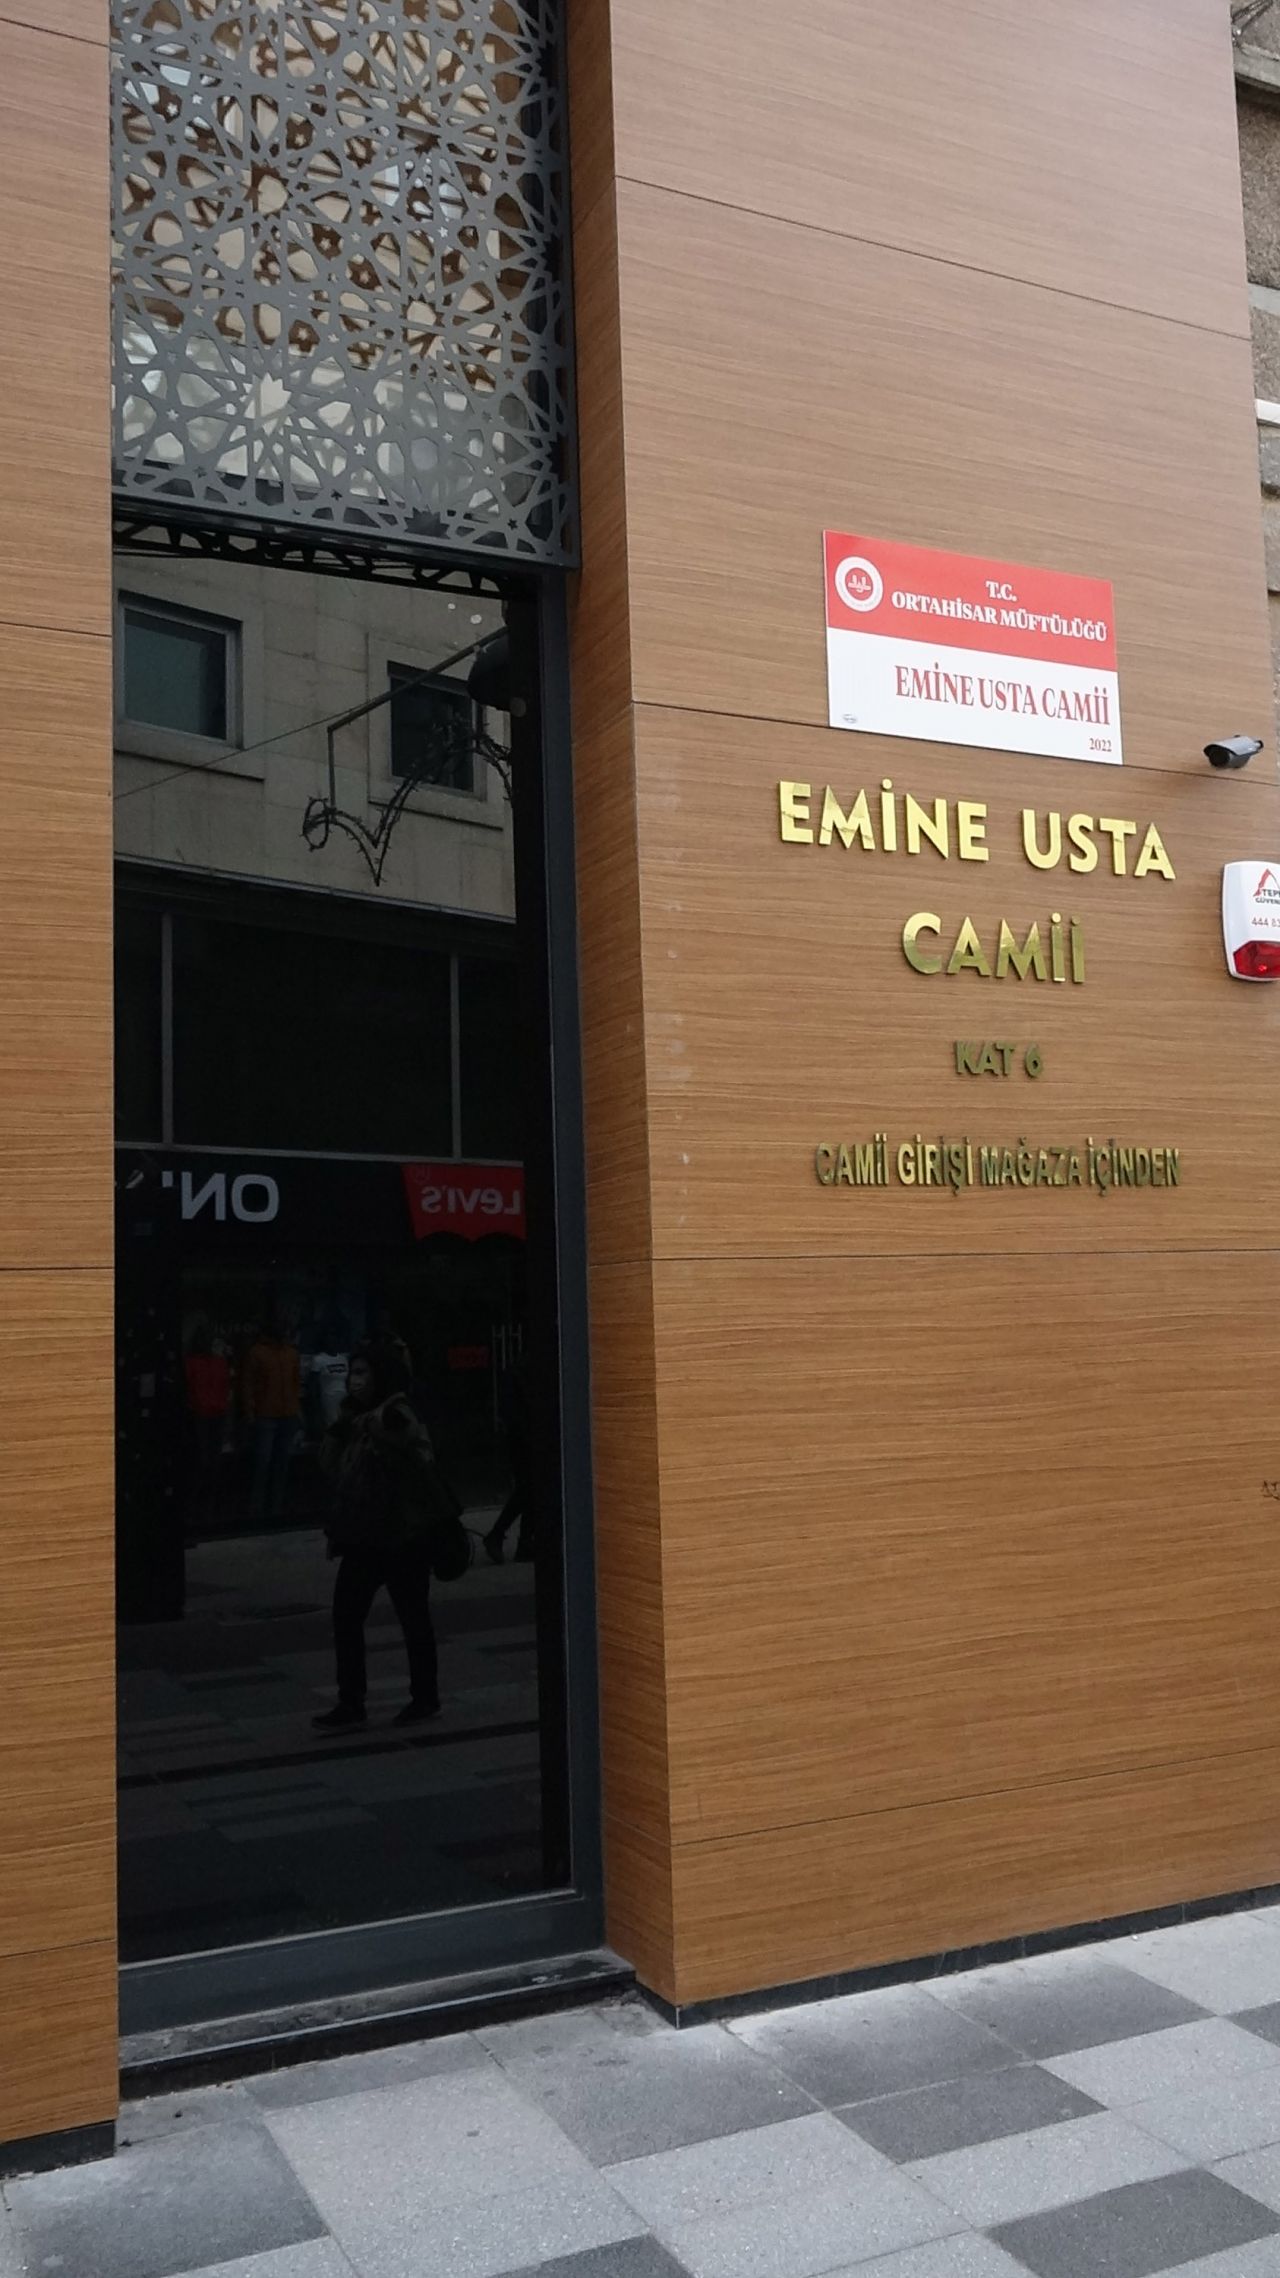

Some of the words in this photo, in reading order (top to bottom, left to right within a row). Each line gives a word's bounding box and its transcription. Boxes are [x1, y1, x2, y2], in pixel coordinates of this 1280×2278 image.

[985, 580, 1018, 602] T.C.
[891, 591, 998, 625] ORTAHİSAR
[999, 608, 1108, 642] MÜFTÜLÜĞÜ
[894, 662, 975, 707] EMİNE
[976, 677, 1039, 716] USTA
[1041, 686, 1111, 726] CAMİİ
[1088, 737, 1113, 753] 2022
[778, 778, 990, 862] EMİNE
[1021, 808, 1177, 881] USTA
[1262, 888, 1280, 898] TEP
[1251, 916, 1269, 927] 444
[902, 912, 1086, 983] CAMİİ
[953, 1040, 1016, 1076] KAT
[1023, 1043, 1044, 1078] 6
[815, 1132, 890, 1186] CAMİİ
[897, 1133, 975, 1197] GİRİŞİ
[980, 1136, 1083, 1187] MAĞAZA
[1087, 1136, 1182, 1197] İÇİNDEN
